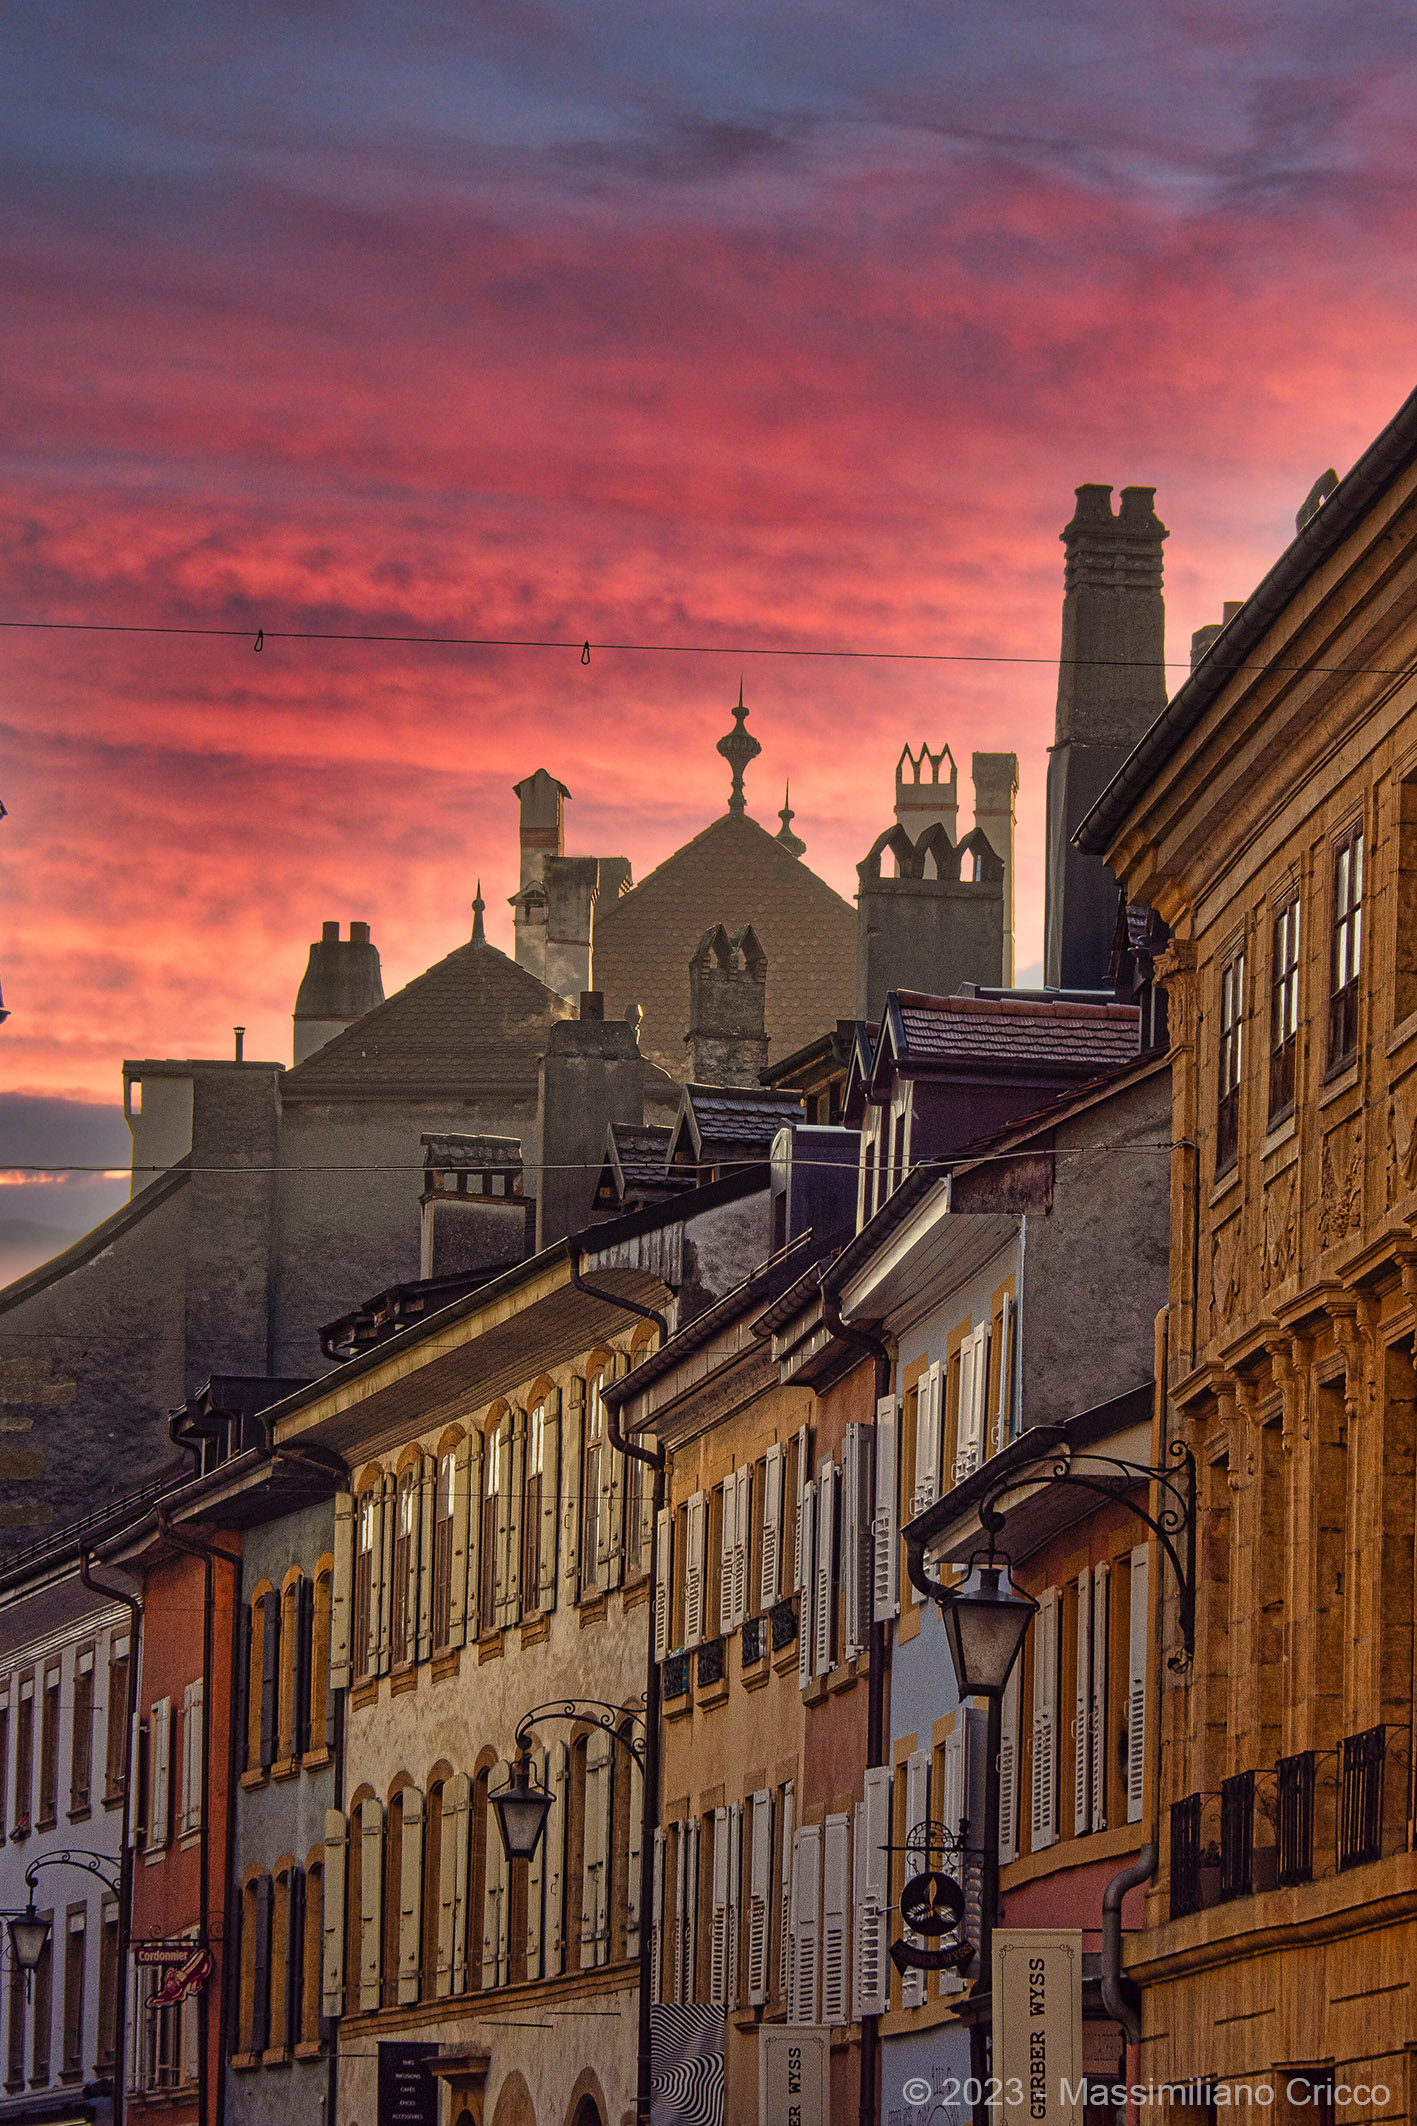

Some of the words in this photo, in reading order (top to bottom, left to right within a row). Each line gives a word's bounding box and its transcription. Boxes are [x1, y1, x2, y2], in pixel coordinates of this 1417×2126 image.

[138, 1949, 189, 1961] Cordonnier
[944, 1943, 973, 1962] WYSS
[1029, 1958, 1045, 2017] WYSS
[788, 2047, 801, 2095] WYSS
[1029, 2030, 1046, 2119] GERBER
